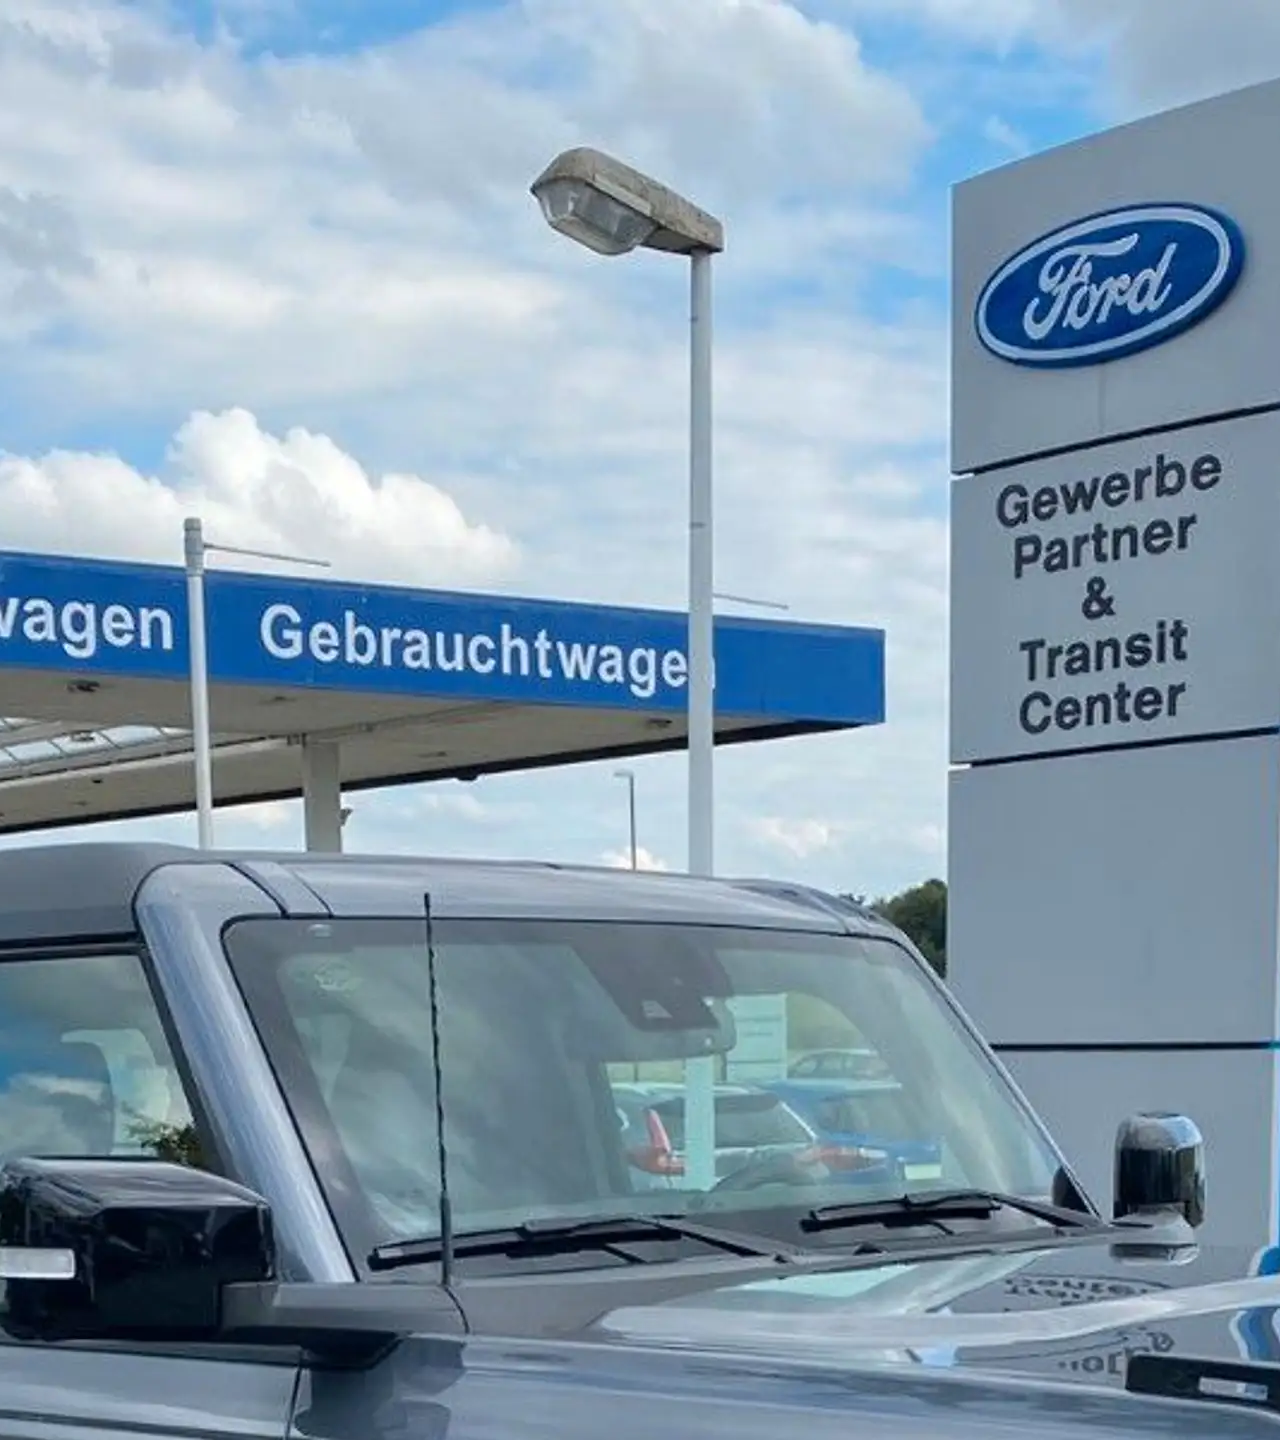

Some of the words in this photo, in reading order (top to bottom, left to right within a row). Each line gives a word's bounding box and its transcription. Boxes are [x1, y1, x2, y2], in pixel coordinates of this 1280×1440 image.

[1022, 232, 1178, 341] Ford
[996, 453, 1222, 529] Gewerbe
[1013, 513, 1198, 579] Partner
[1081, 575, 1116, 620] &
[259, 603, 716, 698] Gebrauchtwage
[1020, 619, 1189, 682] Transit
[1019, 681, 1187, 735] Center
